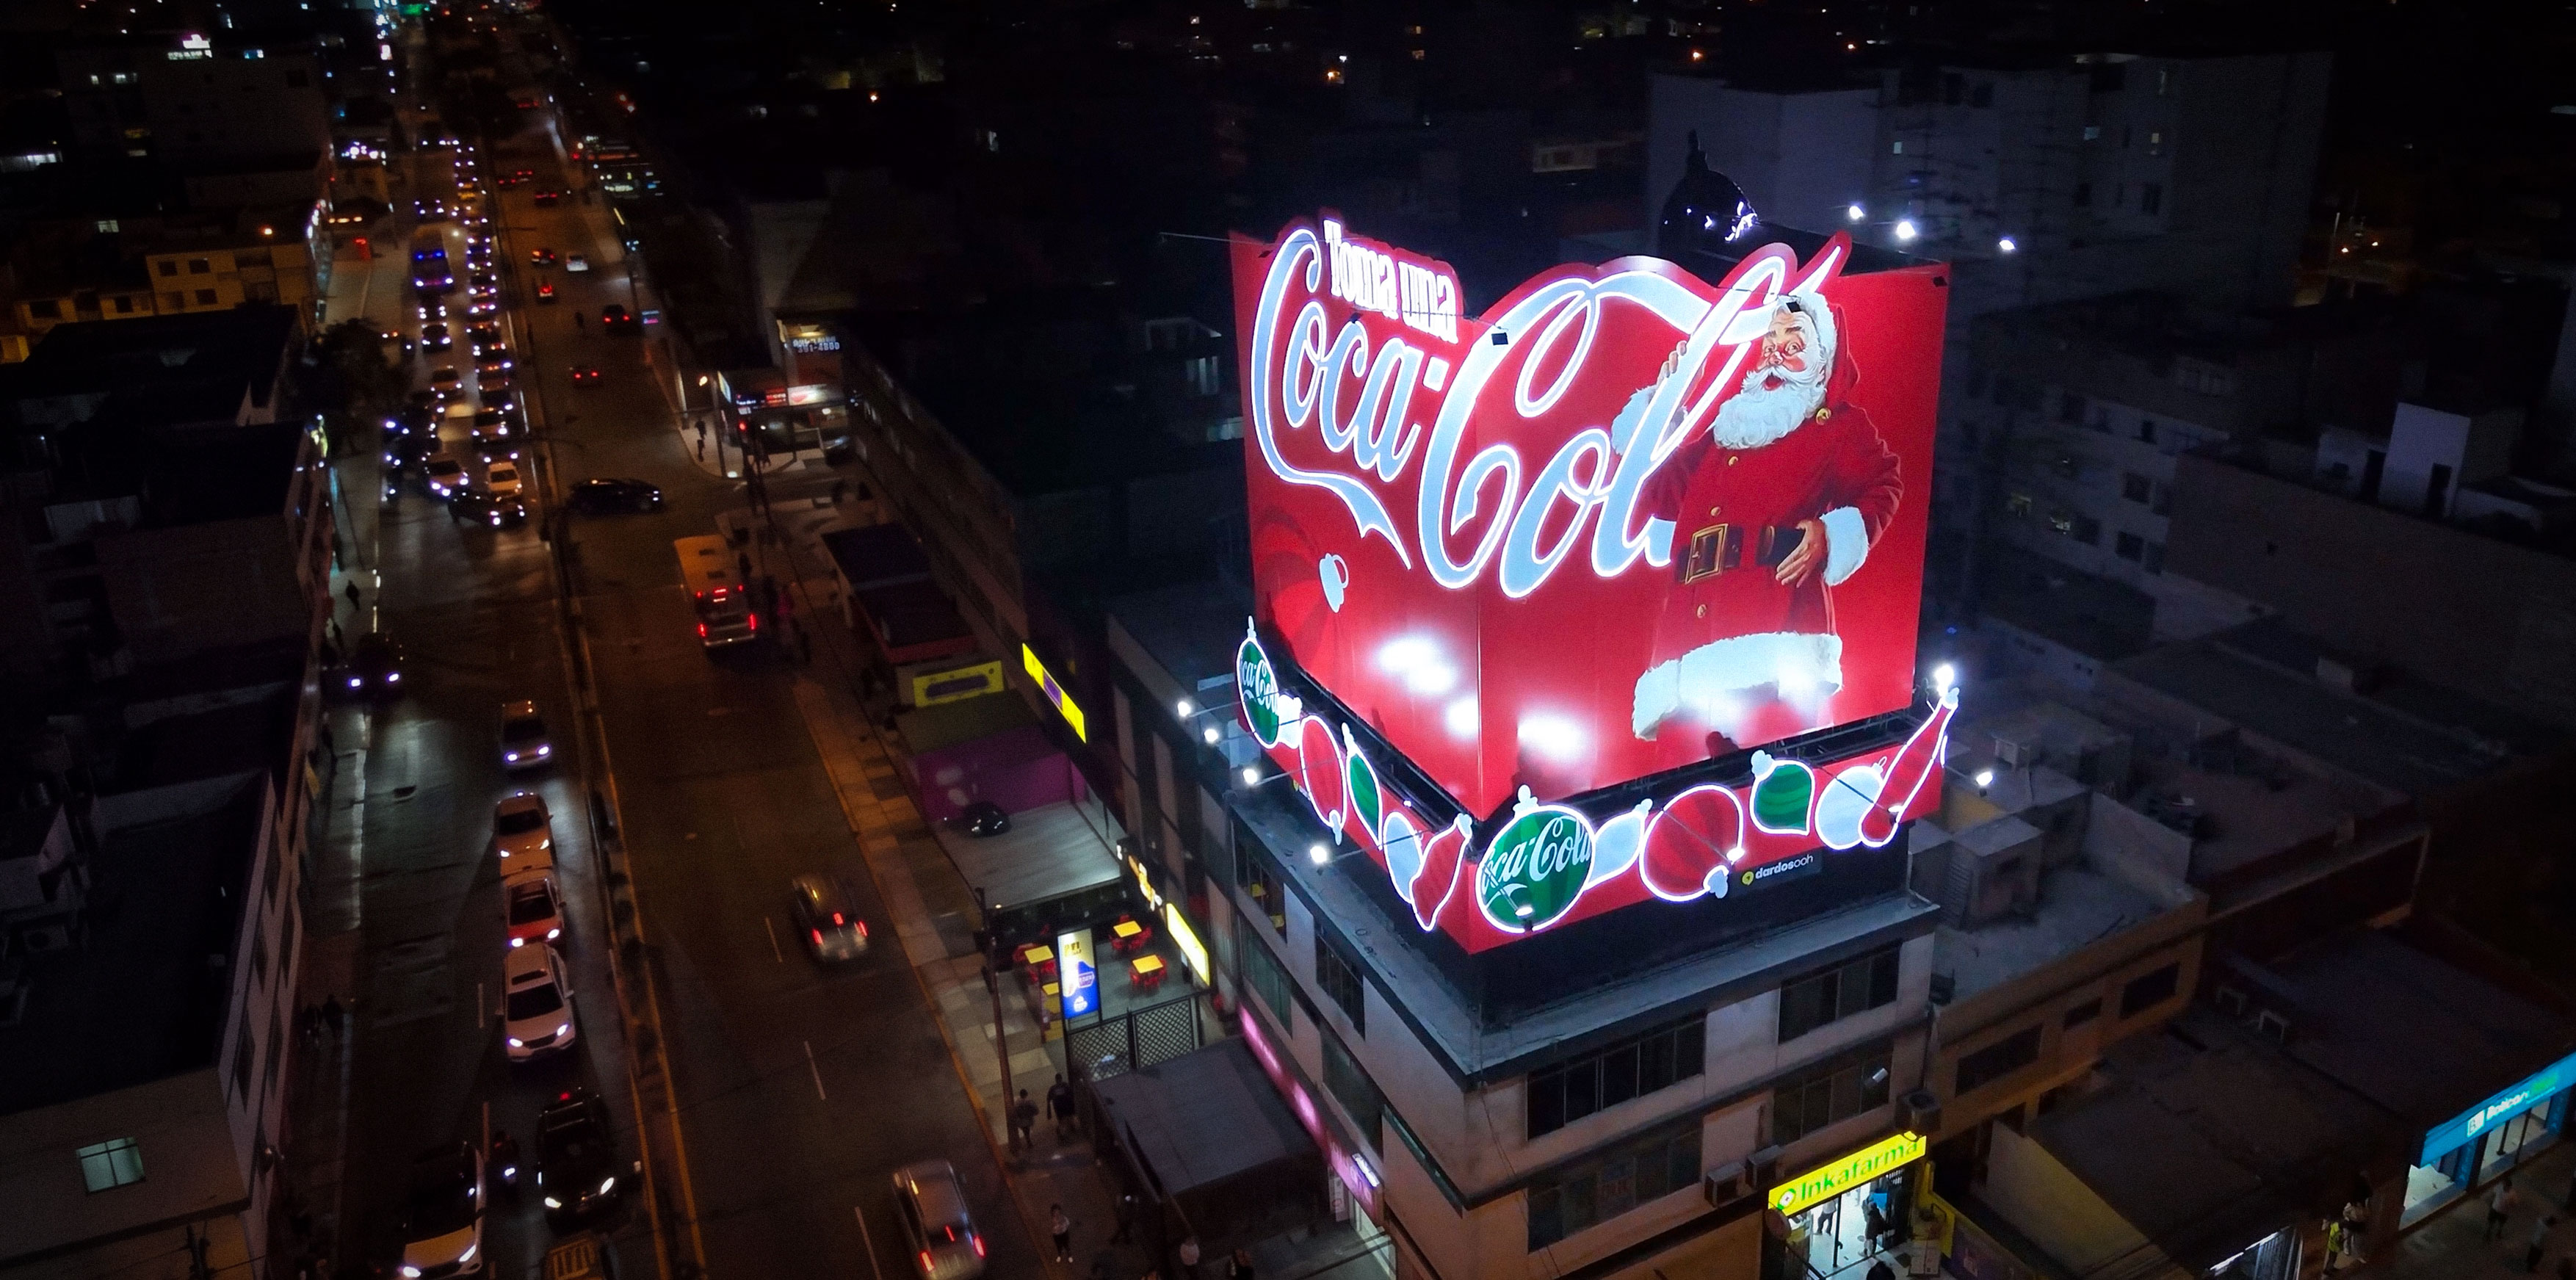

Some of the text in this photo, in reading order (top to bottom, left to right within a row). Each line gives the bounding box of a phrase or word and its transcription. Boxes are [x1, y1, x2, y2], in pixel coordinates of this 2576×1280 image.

[1323, 220, 1458, 344] Toma una
[1251, 226, 1842, 599] Coca-Col
[1481, 815, 1592, 897] oca-Cola
[1755, 854, 1814, 880] dardosooh
[1801, 1141, 1918, 1201] Inkafarma
